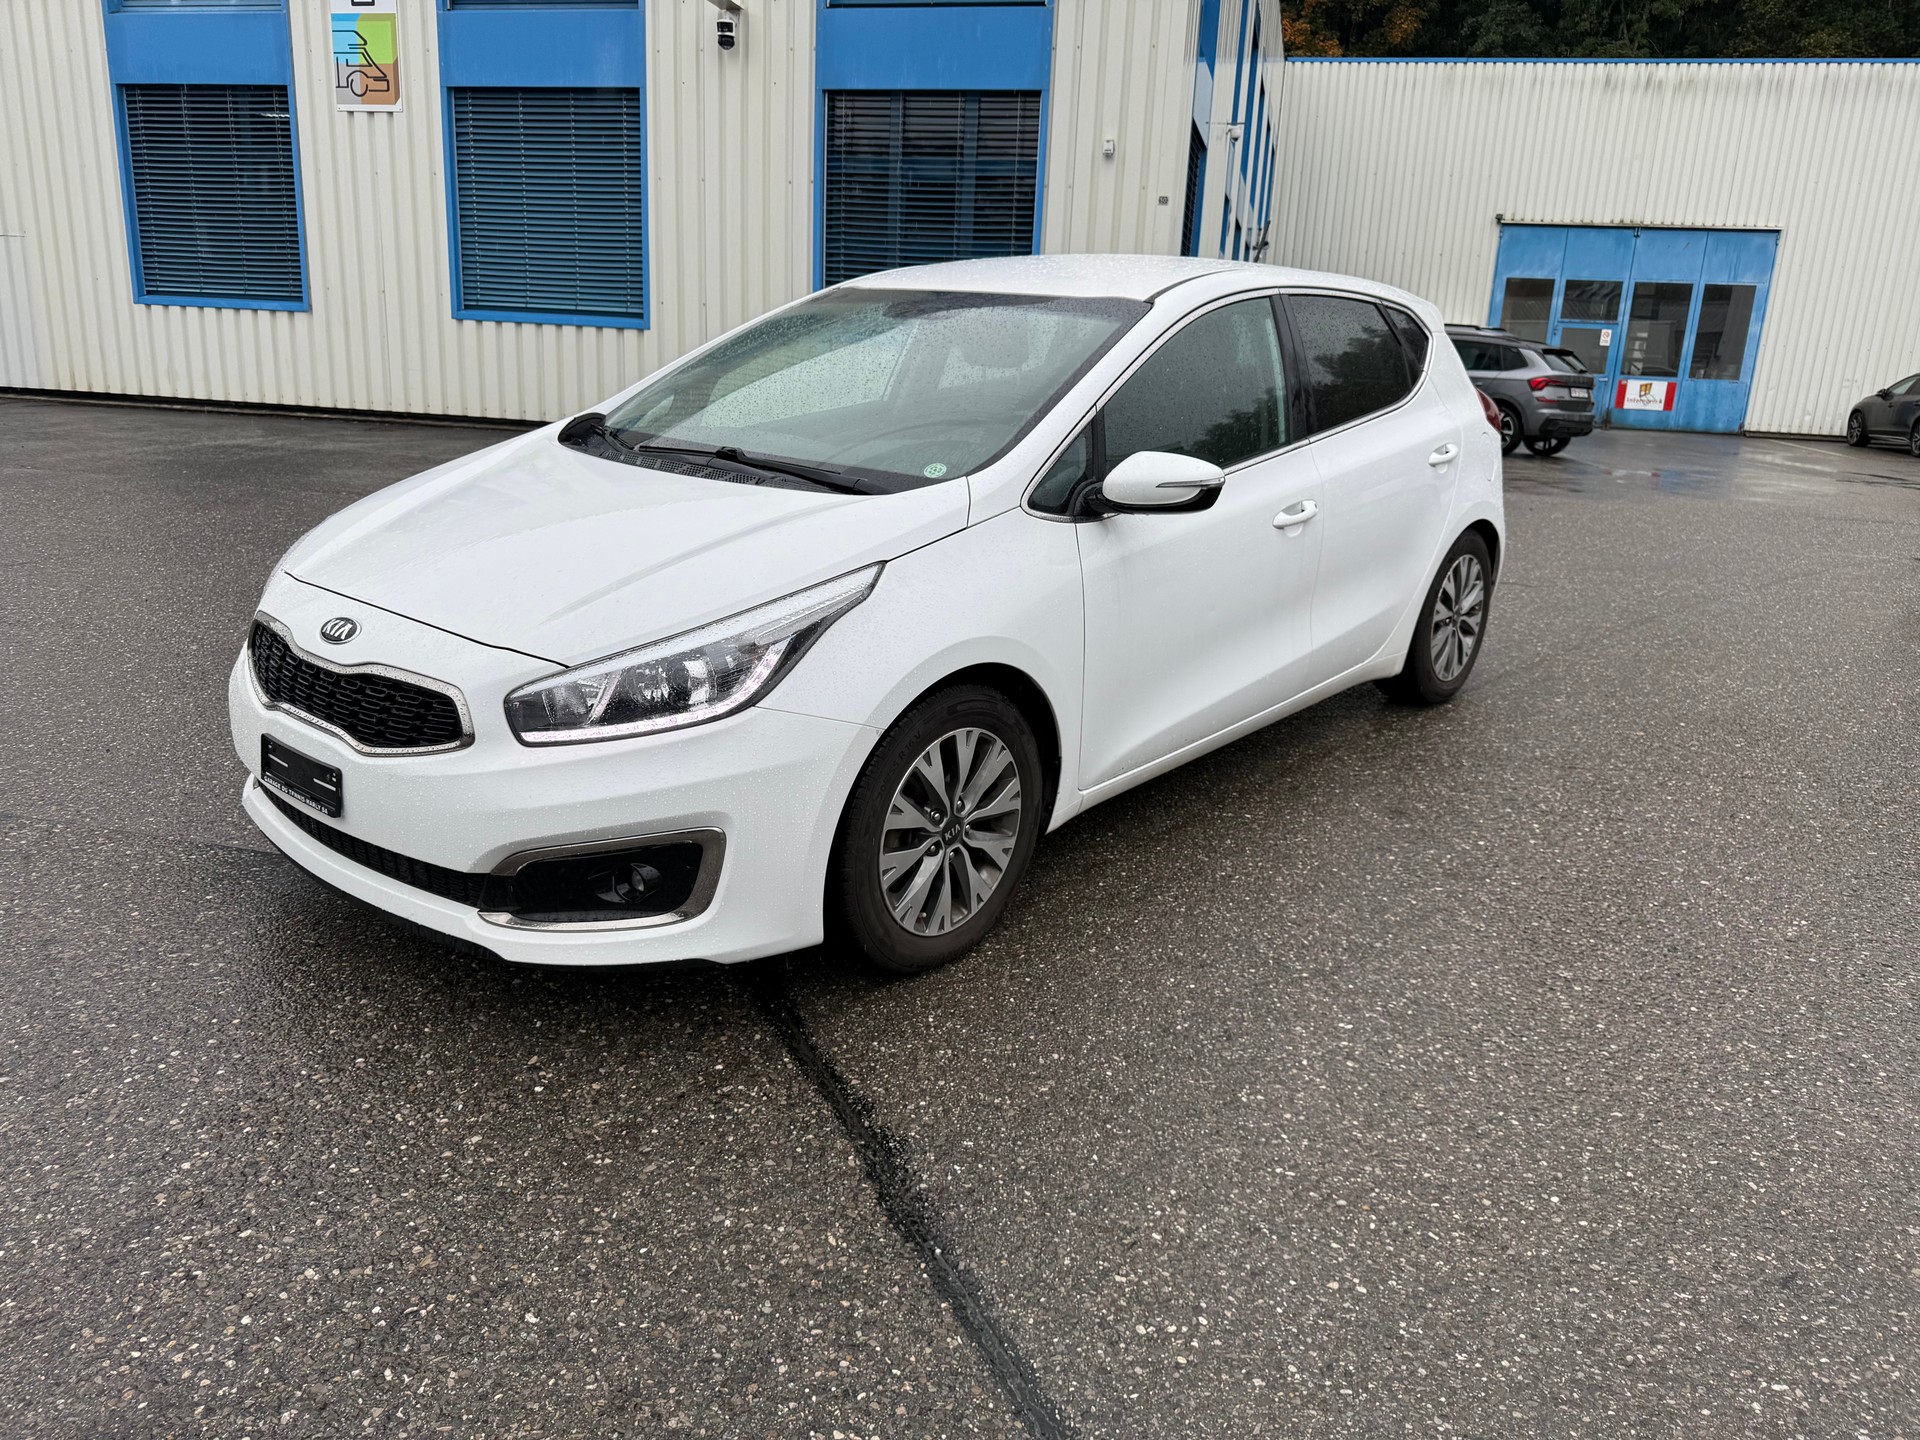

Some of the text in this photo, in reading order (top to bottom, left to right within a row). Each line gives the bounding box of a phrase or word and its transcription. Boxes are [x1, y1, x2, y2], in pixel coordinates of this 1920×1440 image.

[322, 619, 353, 640] KIA
[264, 775, 329, 815] GARAGE DU TENNIS MARLY SA
[944, 823, 961, 841] KIA
